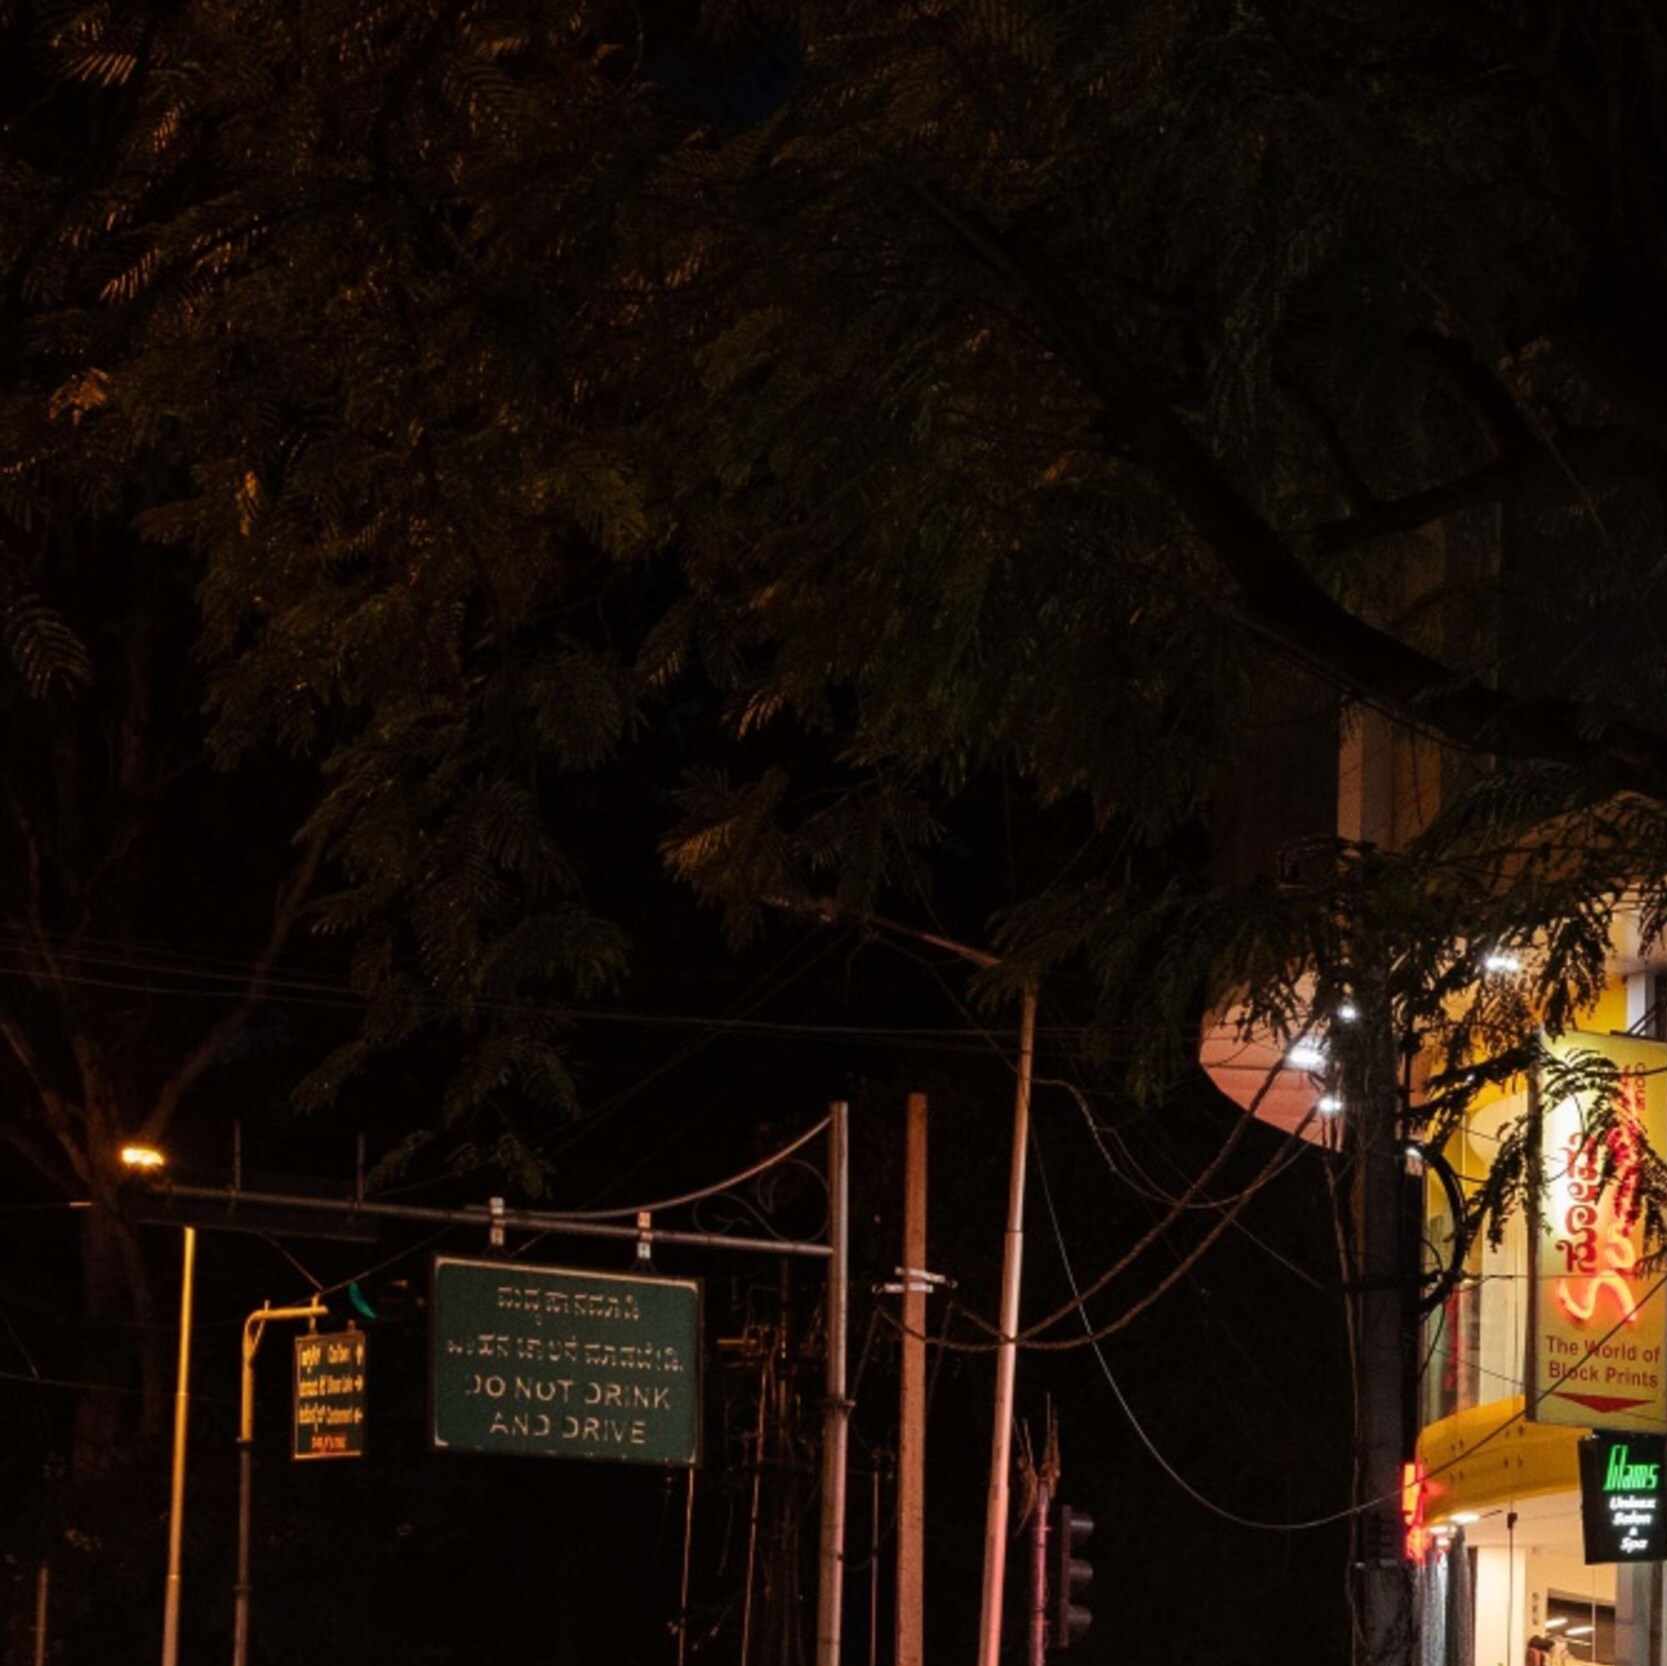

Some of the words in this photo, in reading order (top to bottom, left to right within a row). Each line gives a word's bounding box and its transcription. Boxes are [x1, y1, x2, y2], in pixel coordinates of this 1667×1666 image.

[1545, 1334, 1579, 1356] The
[1585, 1339, 1638, 1361] World
[1642, 1343, 1661, 1363] of
[1548, 1360, 1599, 1382] Block
[1605, 1365, 1658, 1389] Prints
[465, 1373, 507, 1398] DO
[514, 1376, 575, 1402] NOT
[585, 1382, 672, 1410] DRINK
[489, 1411, 551, 1437] AND
[562, 1416, 646, 1445] DRIVE
[1612, 1510, 1653, 1526] Salon
[1620, 1537, 1648, 1554] Spa
